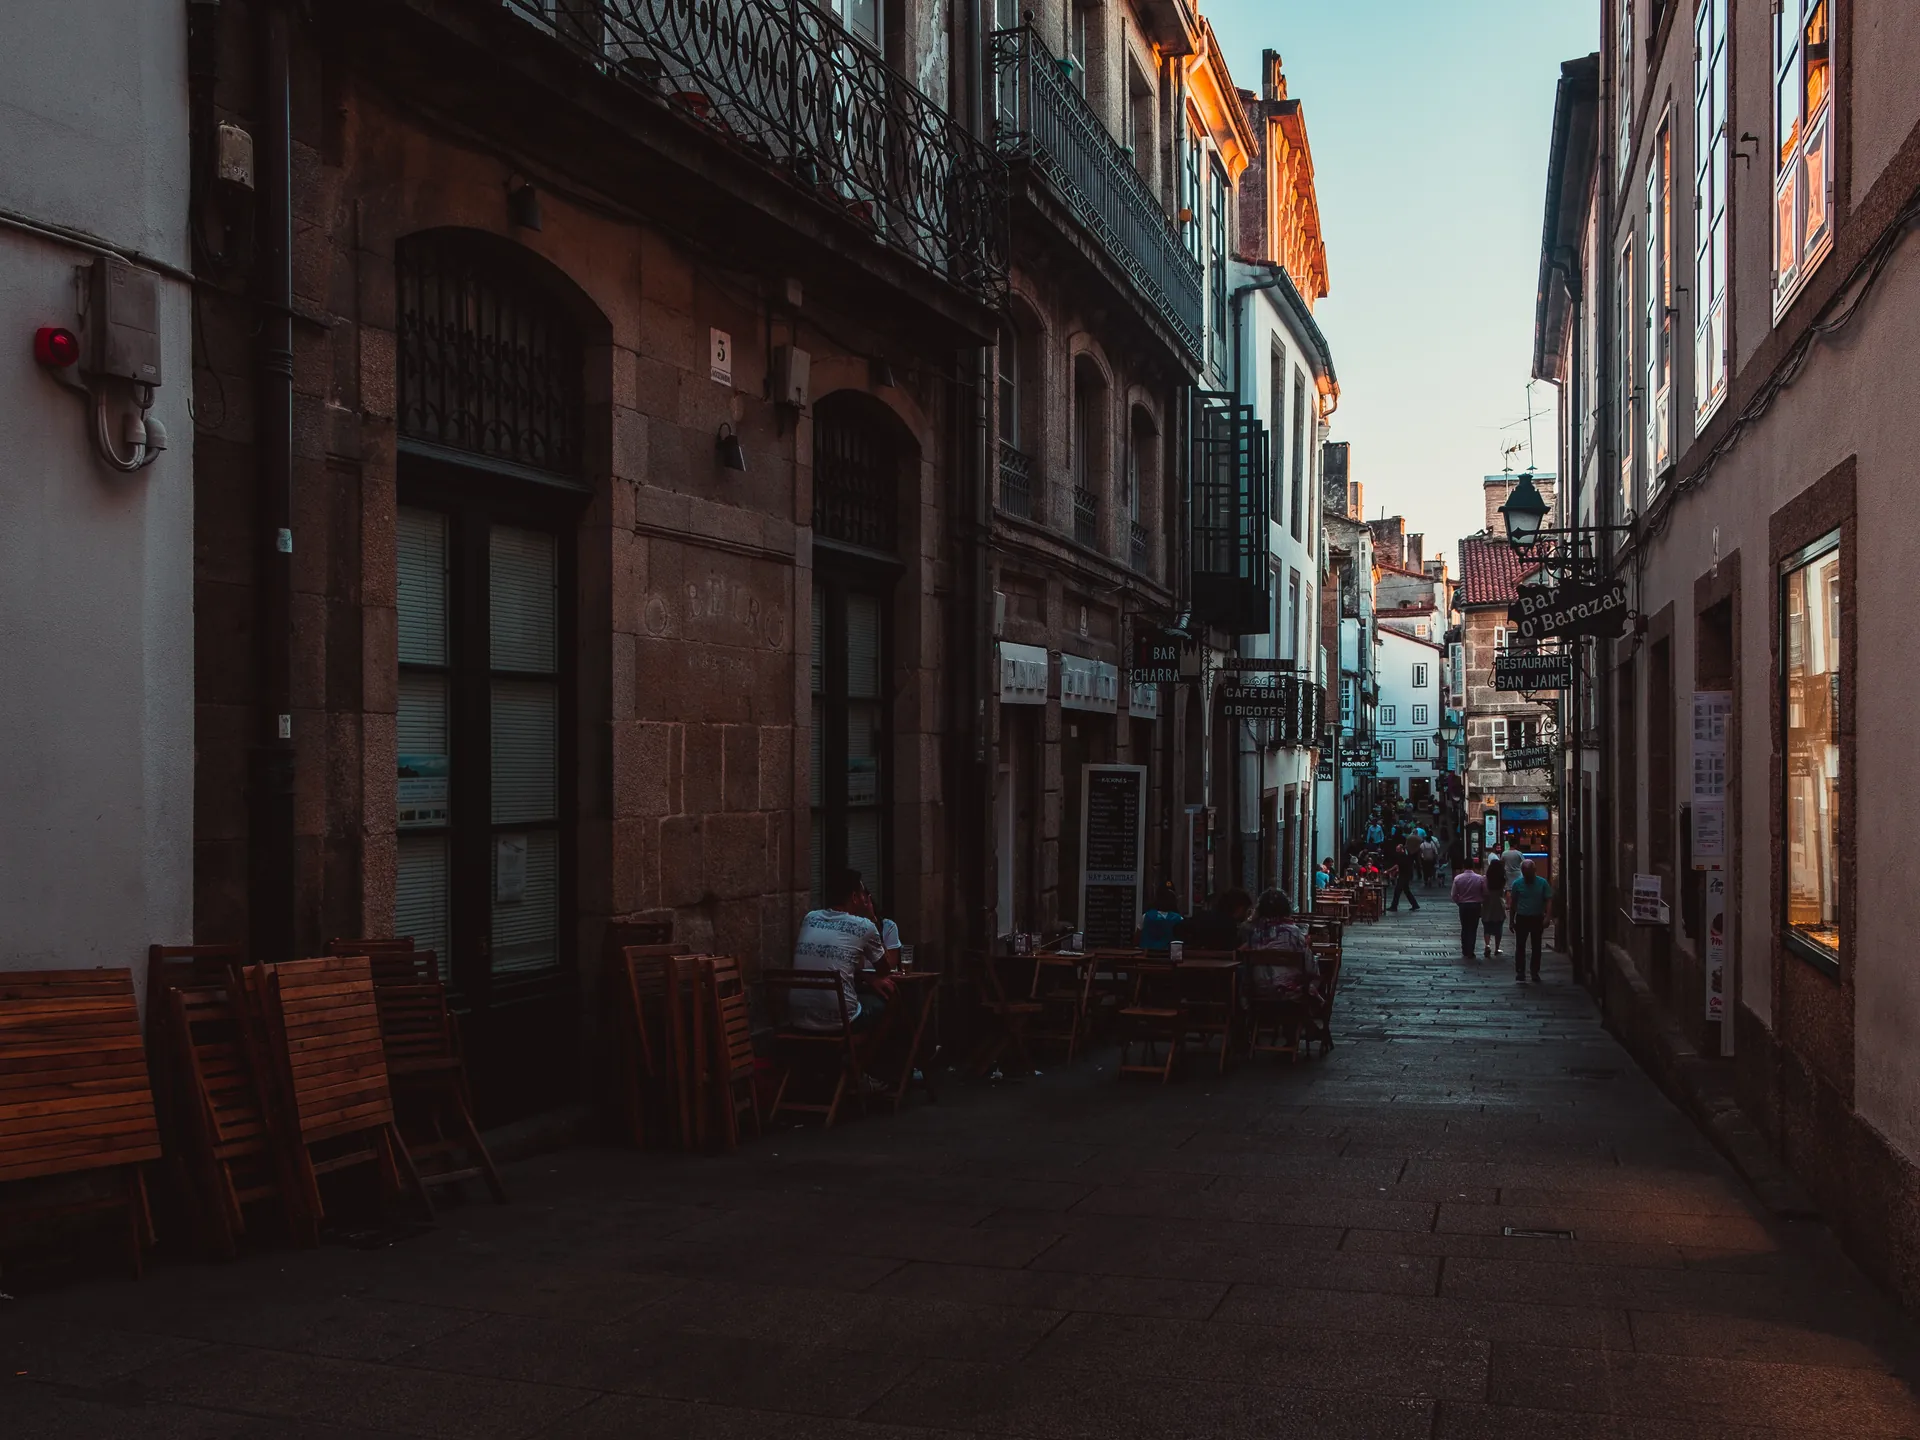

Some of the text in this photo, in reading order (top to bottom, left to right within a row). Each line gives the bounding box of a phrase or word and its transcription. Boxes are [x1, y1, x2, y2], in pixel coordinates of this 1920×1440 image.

[1520, 588, 1560, 616] Bar
[1521, 586, 1626, 638] O'Barazal
[1153, 646, 1176, 660] BAR
[1497, 656, 1569, 670] RESTAURANTE
[1133, 668, 1180, 682] CHARRA
[1497, 673, 1569, 689] SAN JAIME
[1226, 688, 1284, 699] CAFE BAR
[1224, 705, 1233, 715] O
[1504, 746, 1549, 758] RESTAURANTE
[1507, 756, 1547, 770] SAN JAIME
